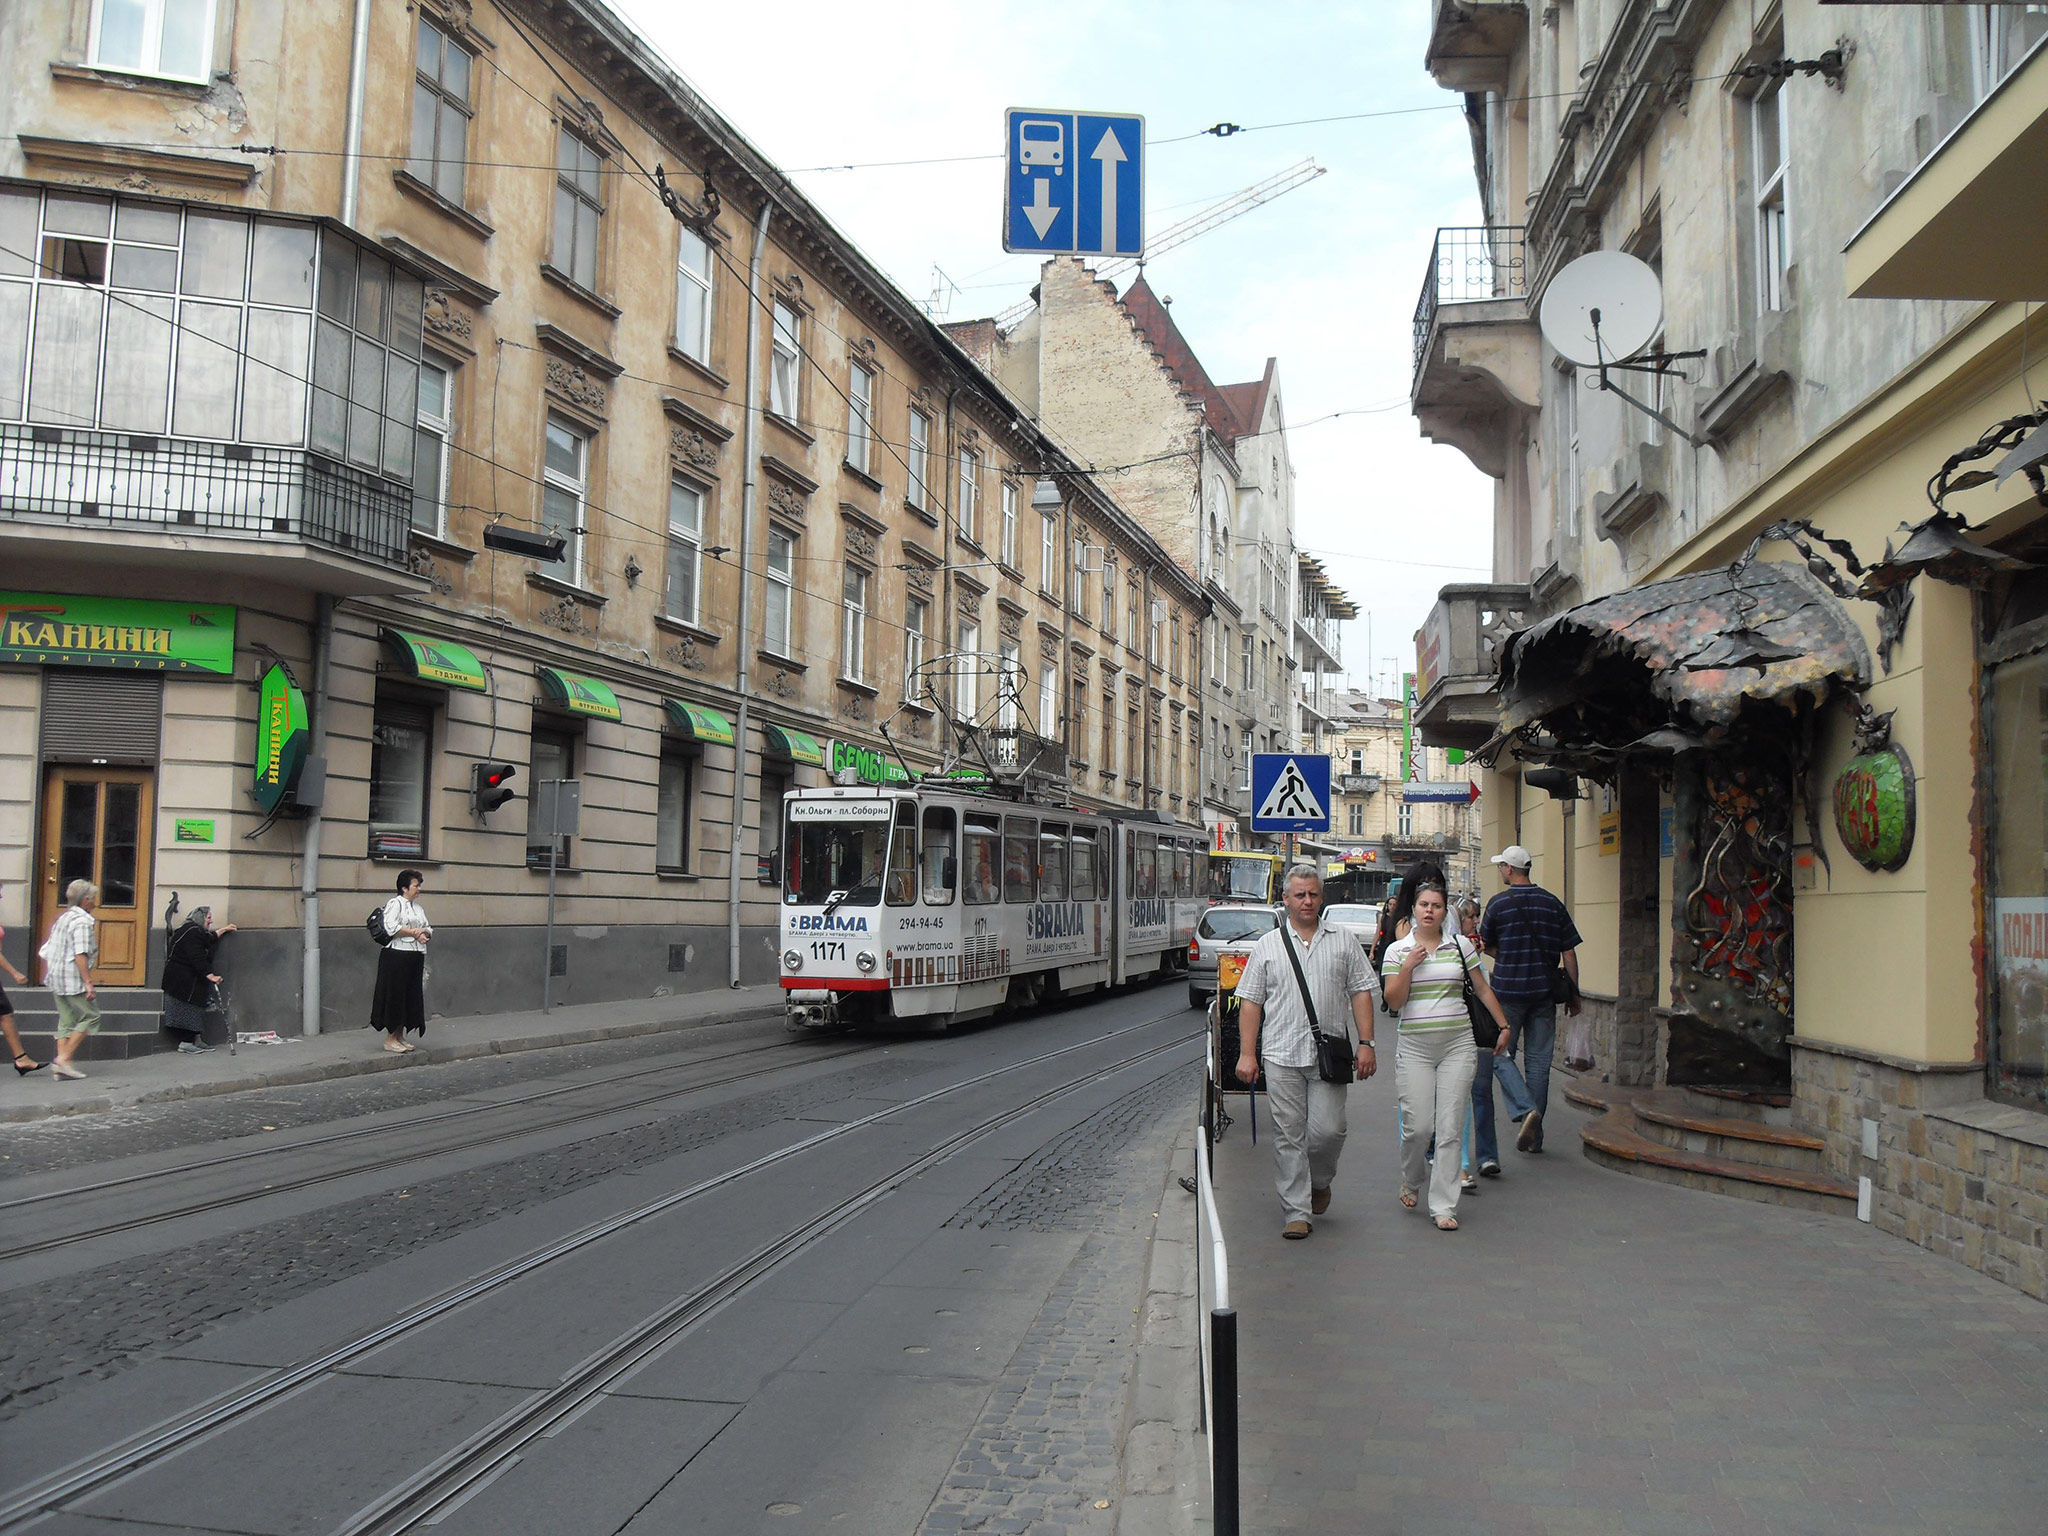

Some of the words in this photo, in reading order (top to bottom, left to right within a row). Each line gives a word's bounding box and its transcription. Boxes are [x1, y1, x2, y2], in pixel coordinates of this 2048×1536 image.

[434, 669, 469, 682] ГУДЗИКИ
[834, 743, 884, 782] БЕМБІ
[795, 806, 832, 815] Кн.Ольги
[839, 806, 889, 816] пл.Соборна
[1035, 903, 1084, 939] BRAMA
[1134, 900, 1167, 928] BRAMA
[799, 915, 868, 932] BRAMA
[900, 917, 944, 930] 294-94-45
[2002, 913, 2048, 959] КОНД
[810, 941, 845, 961] 1171
[896, 941, 954, 952] www.brama.ua
